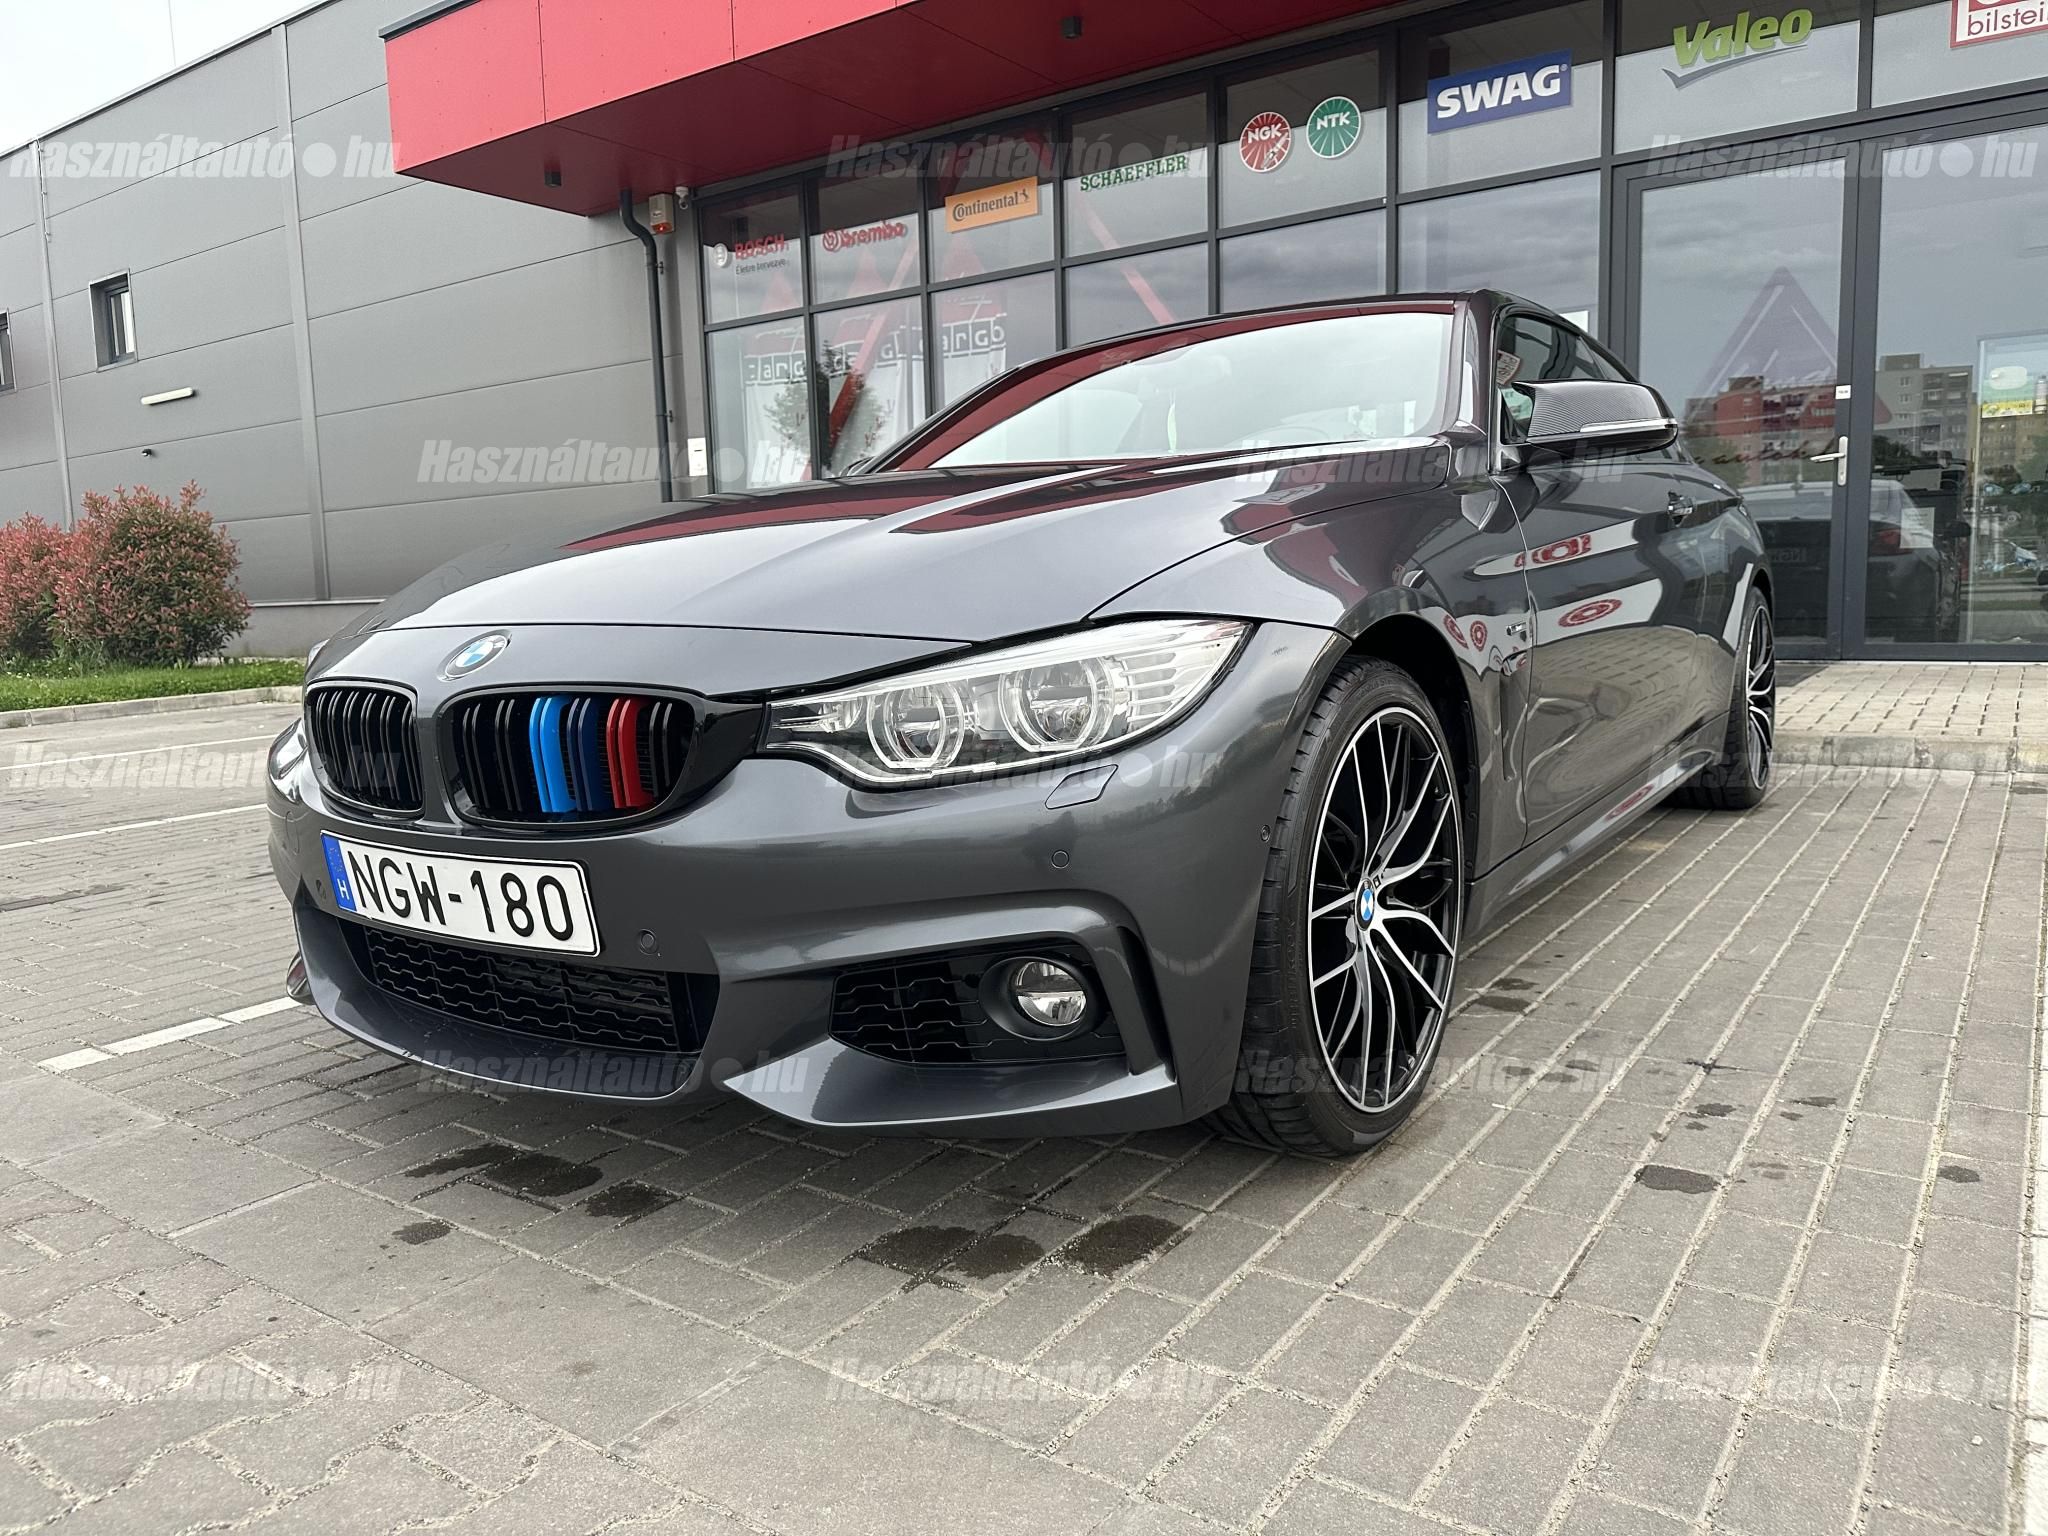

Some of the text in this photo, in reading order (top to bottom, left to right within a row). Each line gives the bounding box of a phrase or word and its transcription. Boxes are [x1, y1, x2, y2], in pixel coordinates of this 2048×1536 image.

[1967, 1, 2048, 36] bilstei
[1673, 8, 1813, 67] Valeo
[1247, 123, 1282, 143] NGK
[1316, 111, 1351, 130] NTK
[1080, 155, 1188, 191] SCHAEFFLER
[953, 191, 1019, 221] Continental
[735, 233, 785, 260] BOSCH
[841, 220, 905, 248] brembo
[337, 878, 350, 900] H
[346, 849, 575, 943] NGW-180
